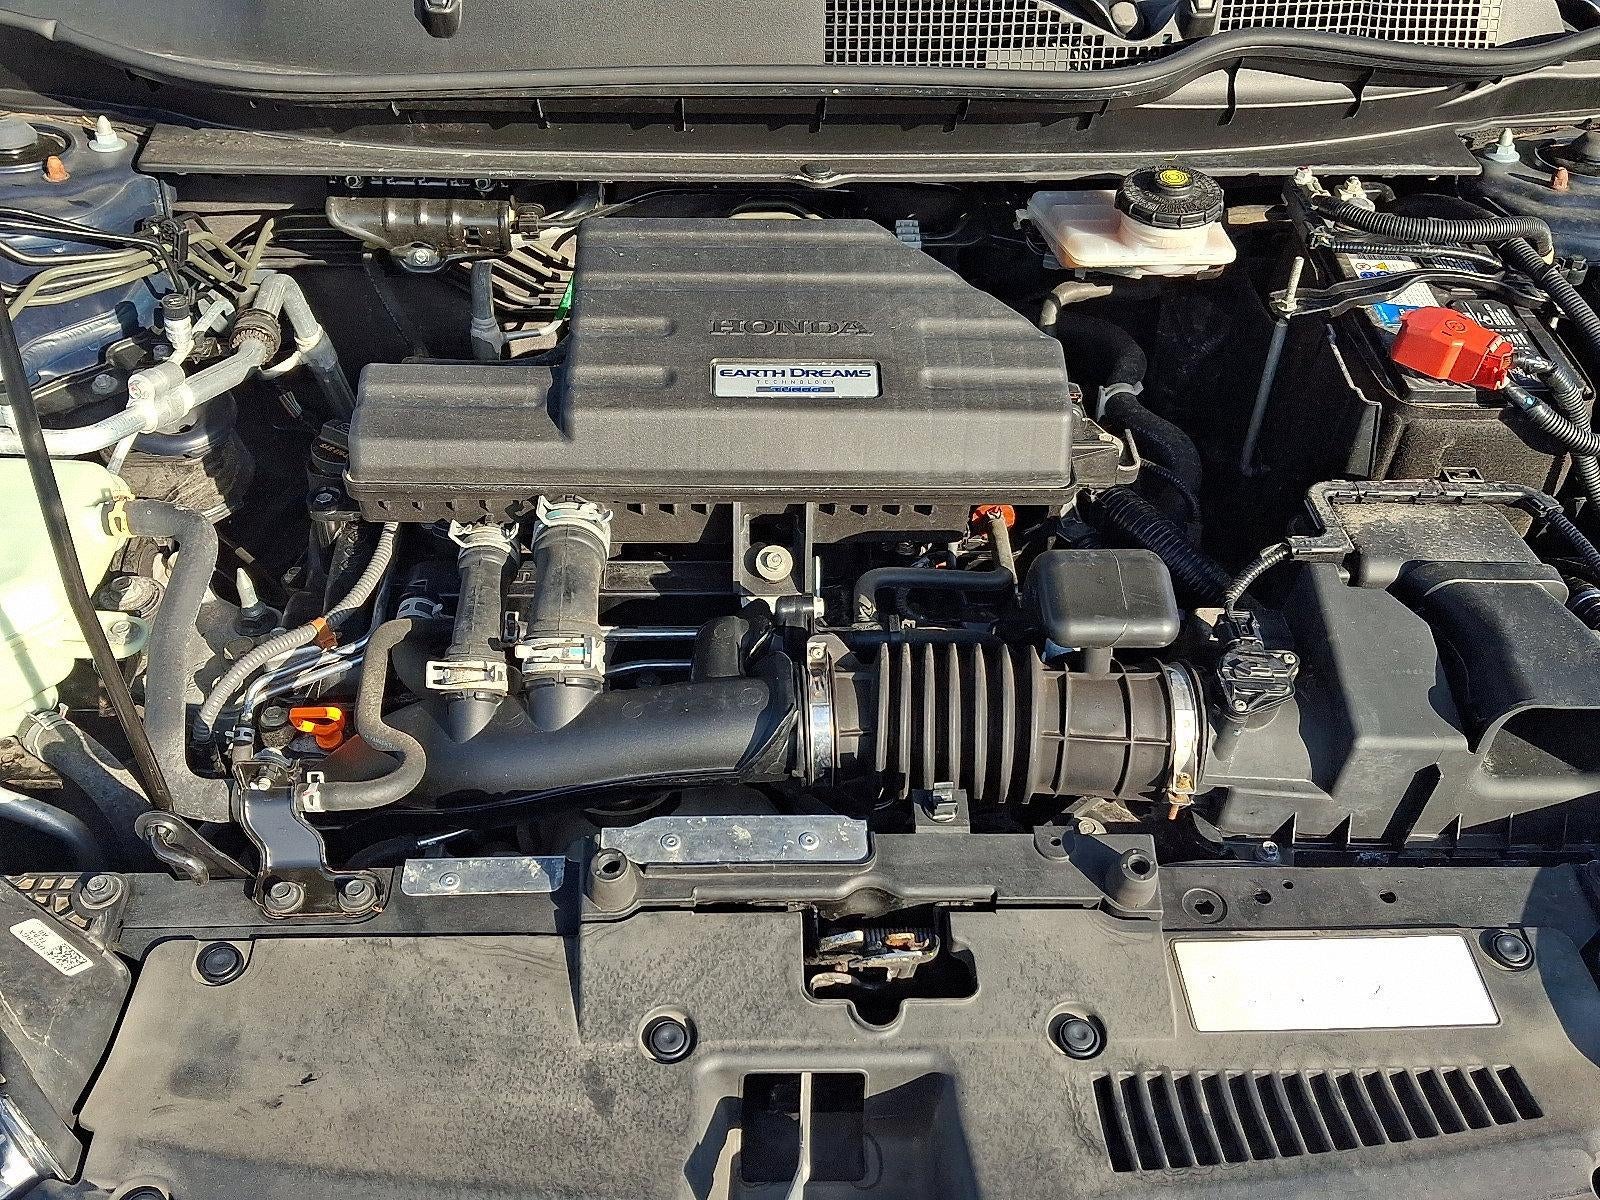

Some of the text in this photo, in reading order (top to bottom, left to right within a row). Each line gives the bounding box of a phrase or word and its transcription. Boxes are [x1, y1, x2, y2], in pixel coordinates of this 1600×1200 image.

[709, 319, 874, 337] HONDA
[719, 367, 872, 378] EARTH DREAMS
